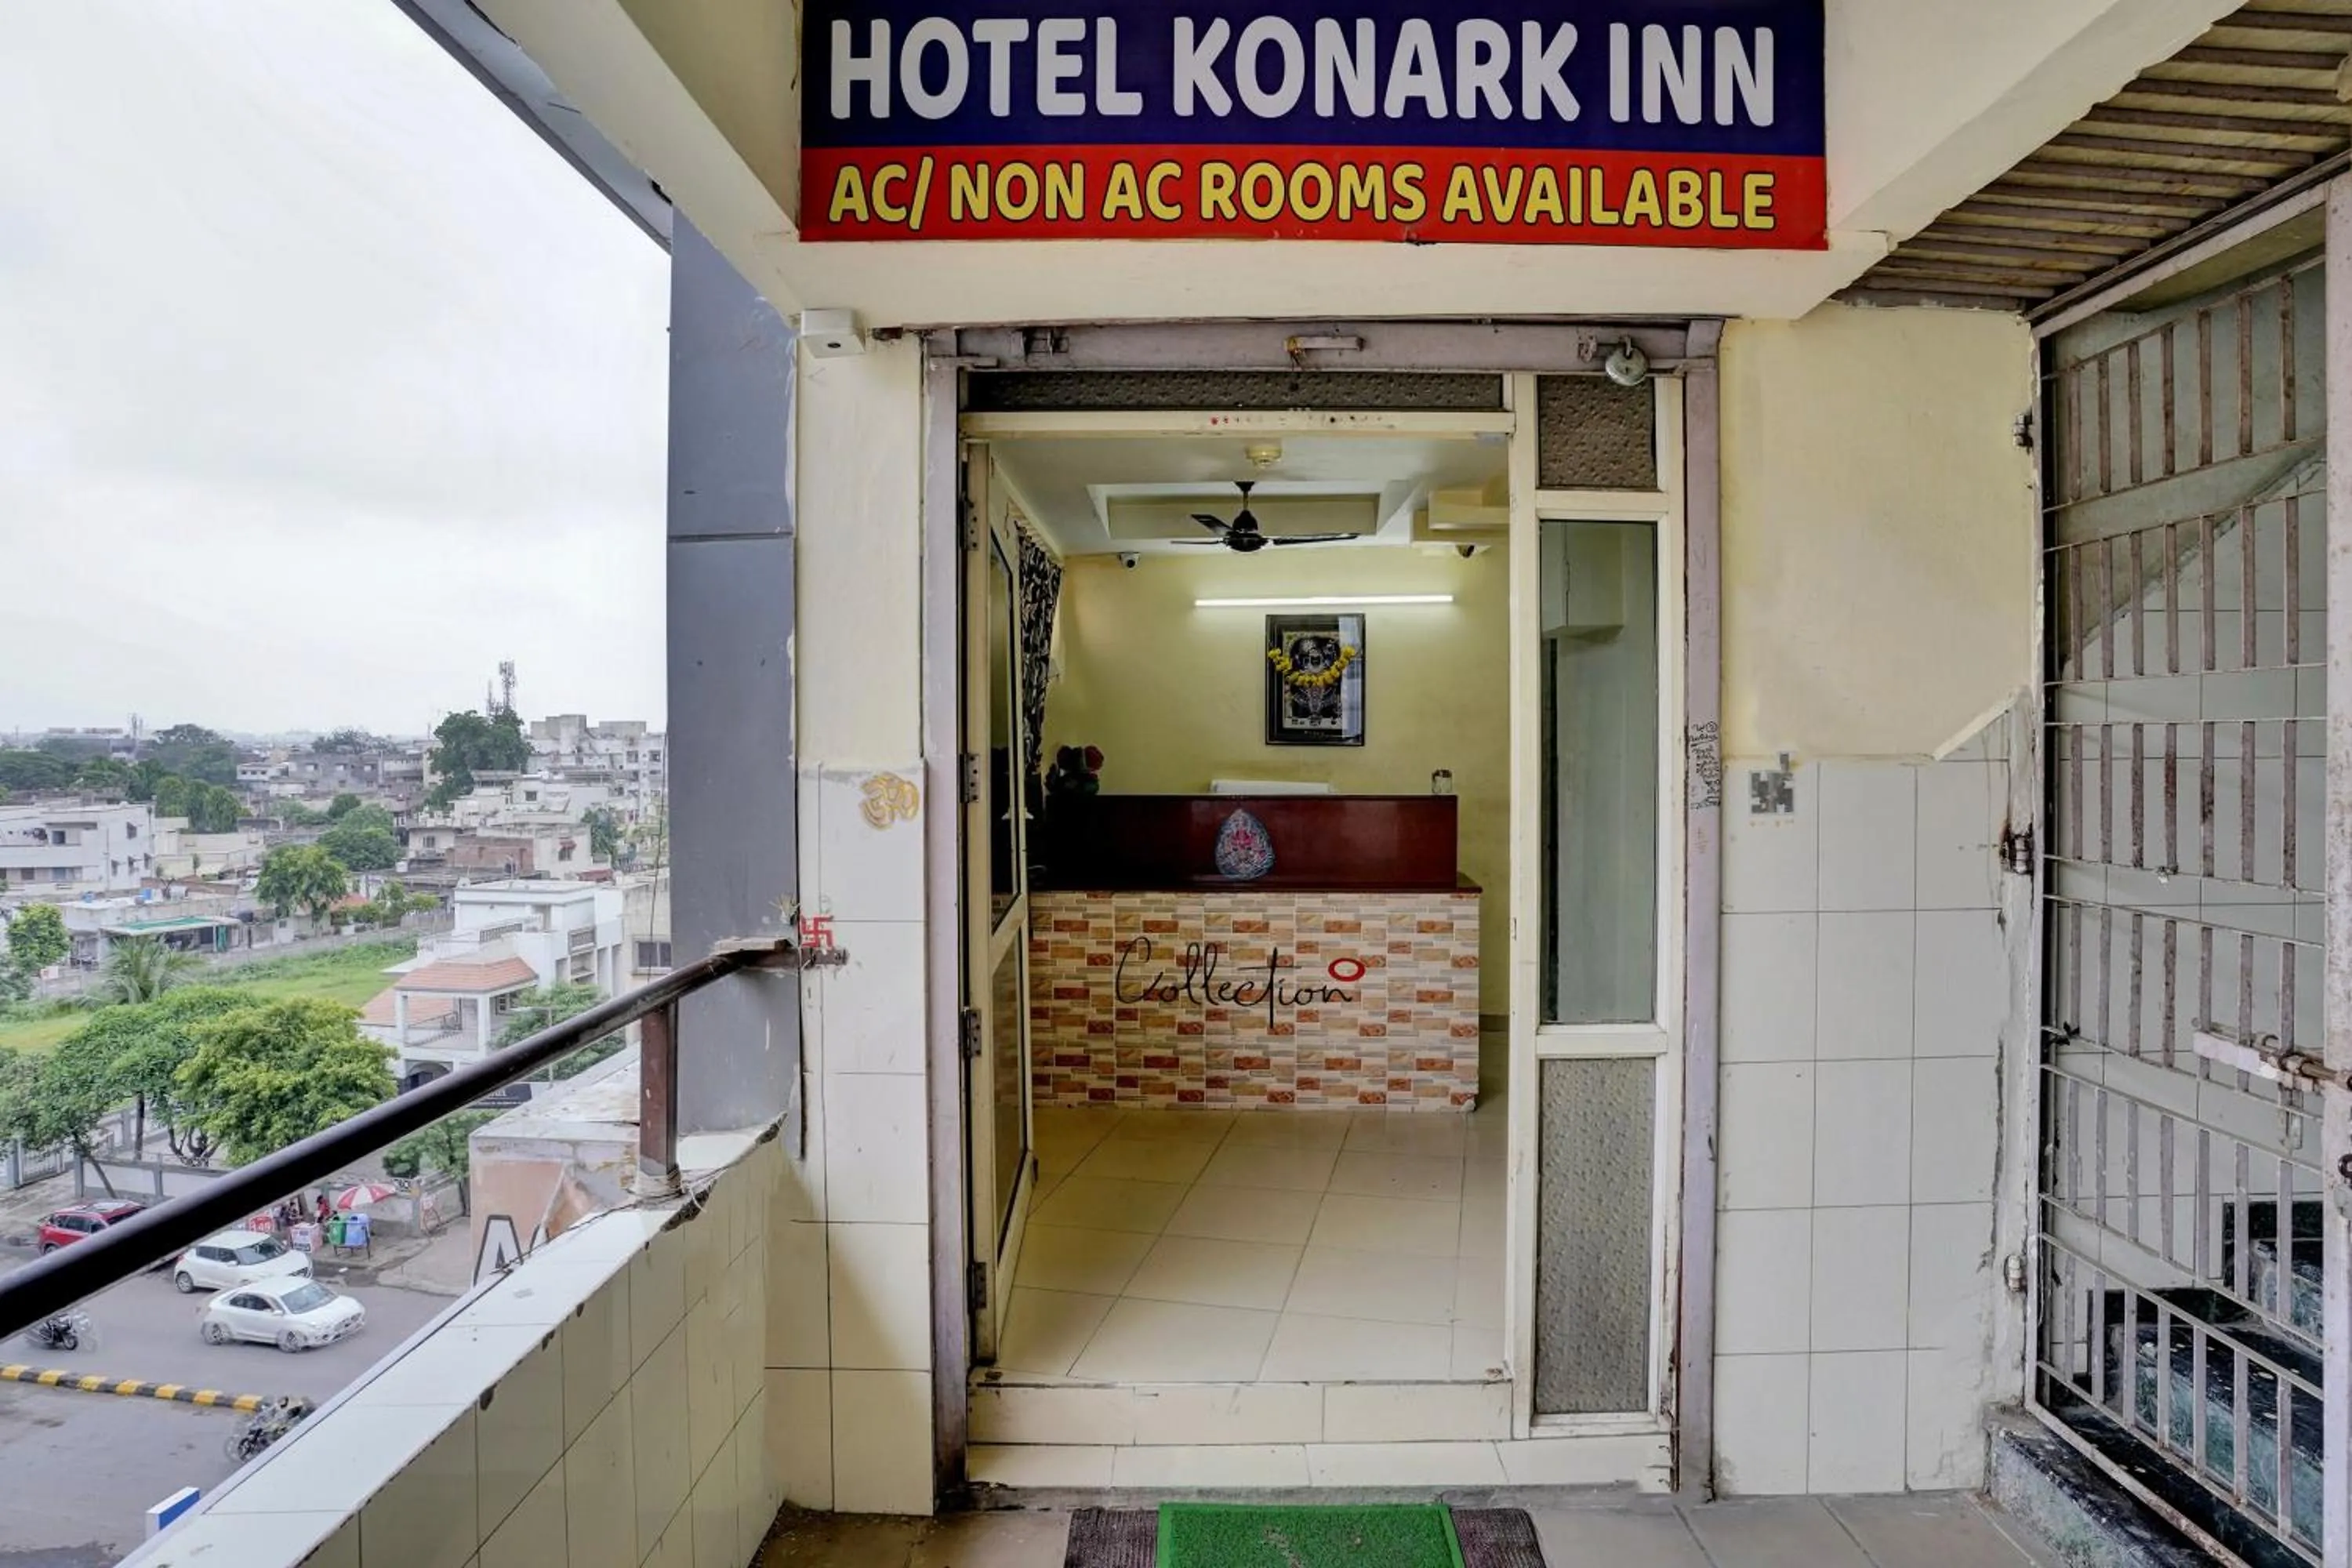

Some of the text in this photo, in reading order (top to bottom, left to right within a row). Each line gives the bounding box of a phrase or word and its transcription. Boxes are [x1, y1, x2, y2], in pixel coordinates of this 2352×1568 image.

[829, 15, 1775, 126] HOTEL KONARK INN
[828, 155, 1775, 230] AC/ NON AC ROOMS AVAILABLE
[1115, 936, 1353, 1029] Collection
